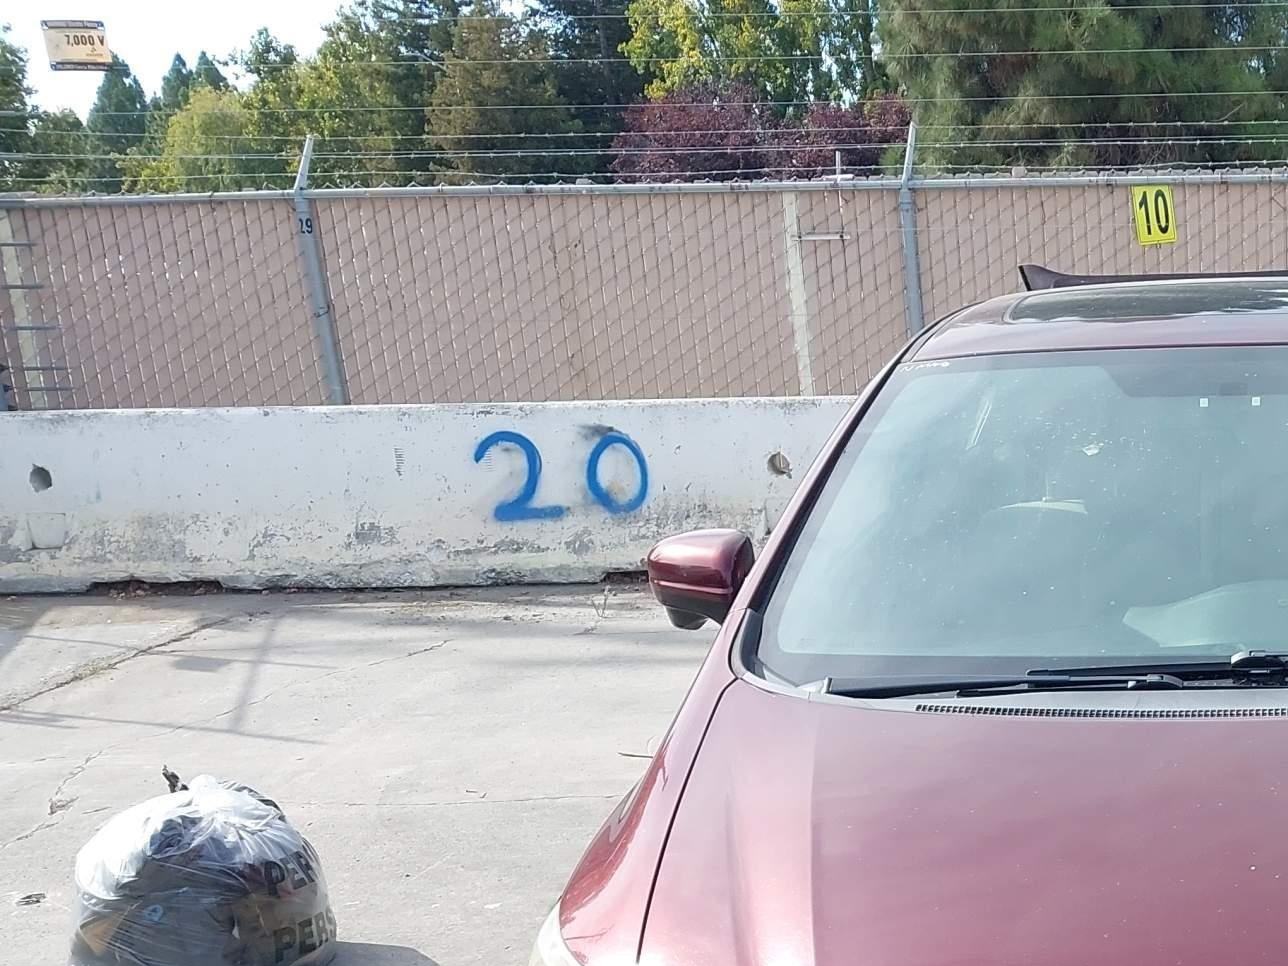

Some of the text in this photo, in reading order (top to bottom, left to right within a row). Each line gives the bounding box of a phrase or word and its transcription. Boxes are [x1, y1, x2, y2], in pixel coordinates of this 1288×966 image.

[64, 34, 104, 47] 7,000 V
[1138, 190, 1169, 235] 10
[474, 430, 648, 522] 20
